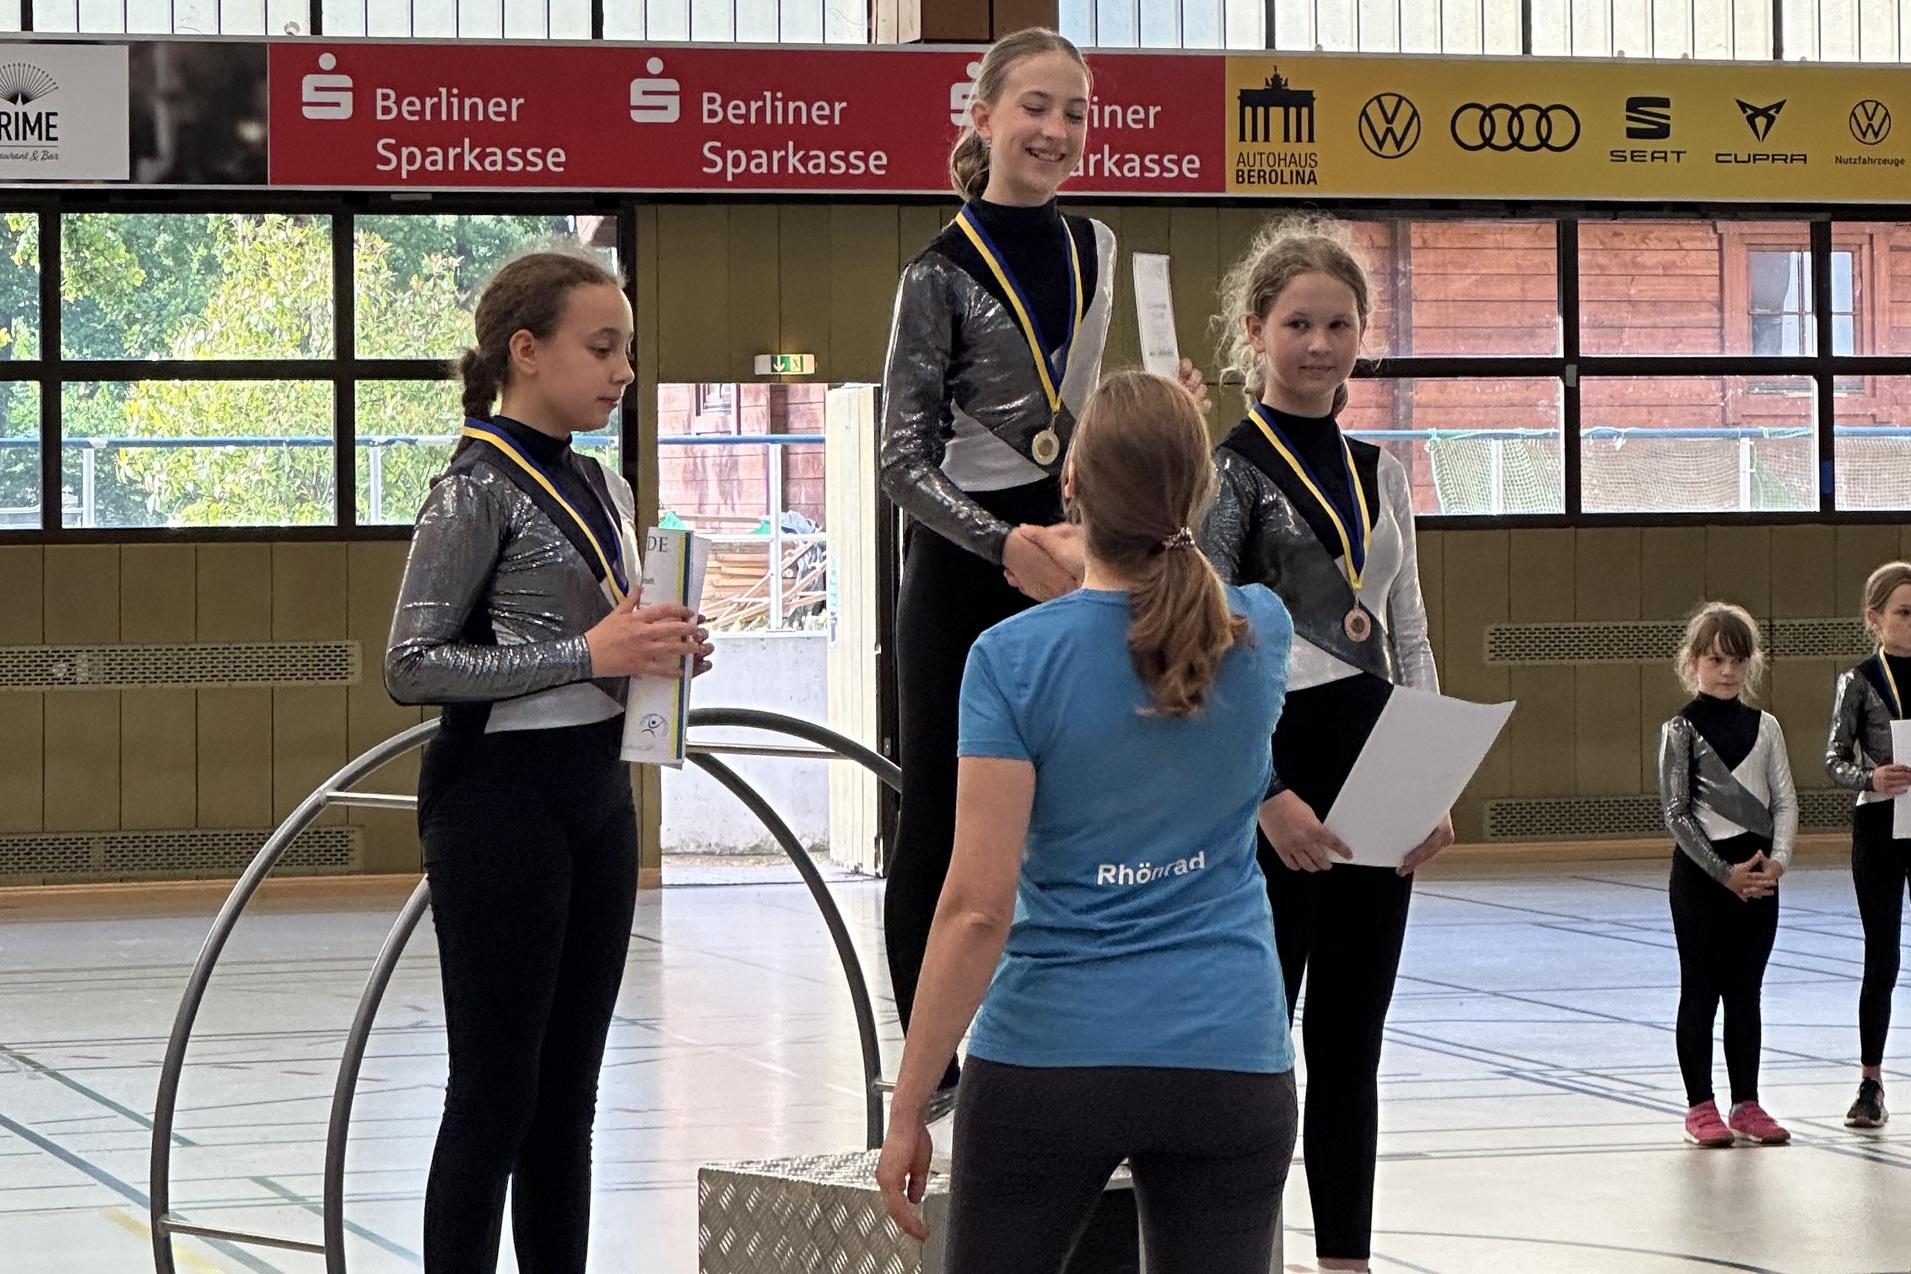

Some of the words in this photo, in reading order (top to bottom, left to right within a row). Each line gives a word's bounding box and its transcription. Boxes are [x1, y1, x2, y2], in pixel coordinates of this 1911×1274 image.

[375, 88, 525, 122] Berliner
[702, 91, 848, 125] Berliner
[1090, 96, 1161, 129] iner
[0, 111, 59, 141] RIME
[375, 138, 567, 179] Sparkasse
[702, 141, 889, 181] Sparkasse
[1069, 144, 1201, 178] arkasse
[1235, 151, 1318, 168] AUTOHAUS
[1609, 150, 1687, 163] SEAT
[1715, 153, 1808, 164] CUPRA
[1834, 155, 1905, 167] Nutzfahrzeuge
[1235, 169, 1318, 185] BEROLINA
[647, 535, 668, 552] DE
[1097, 851, 1206, 885] Rhönrad
